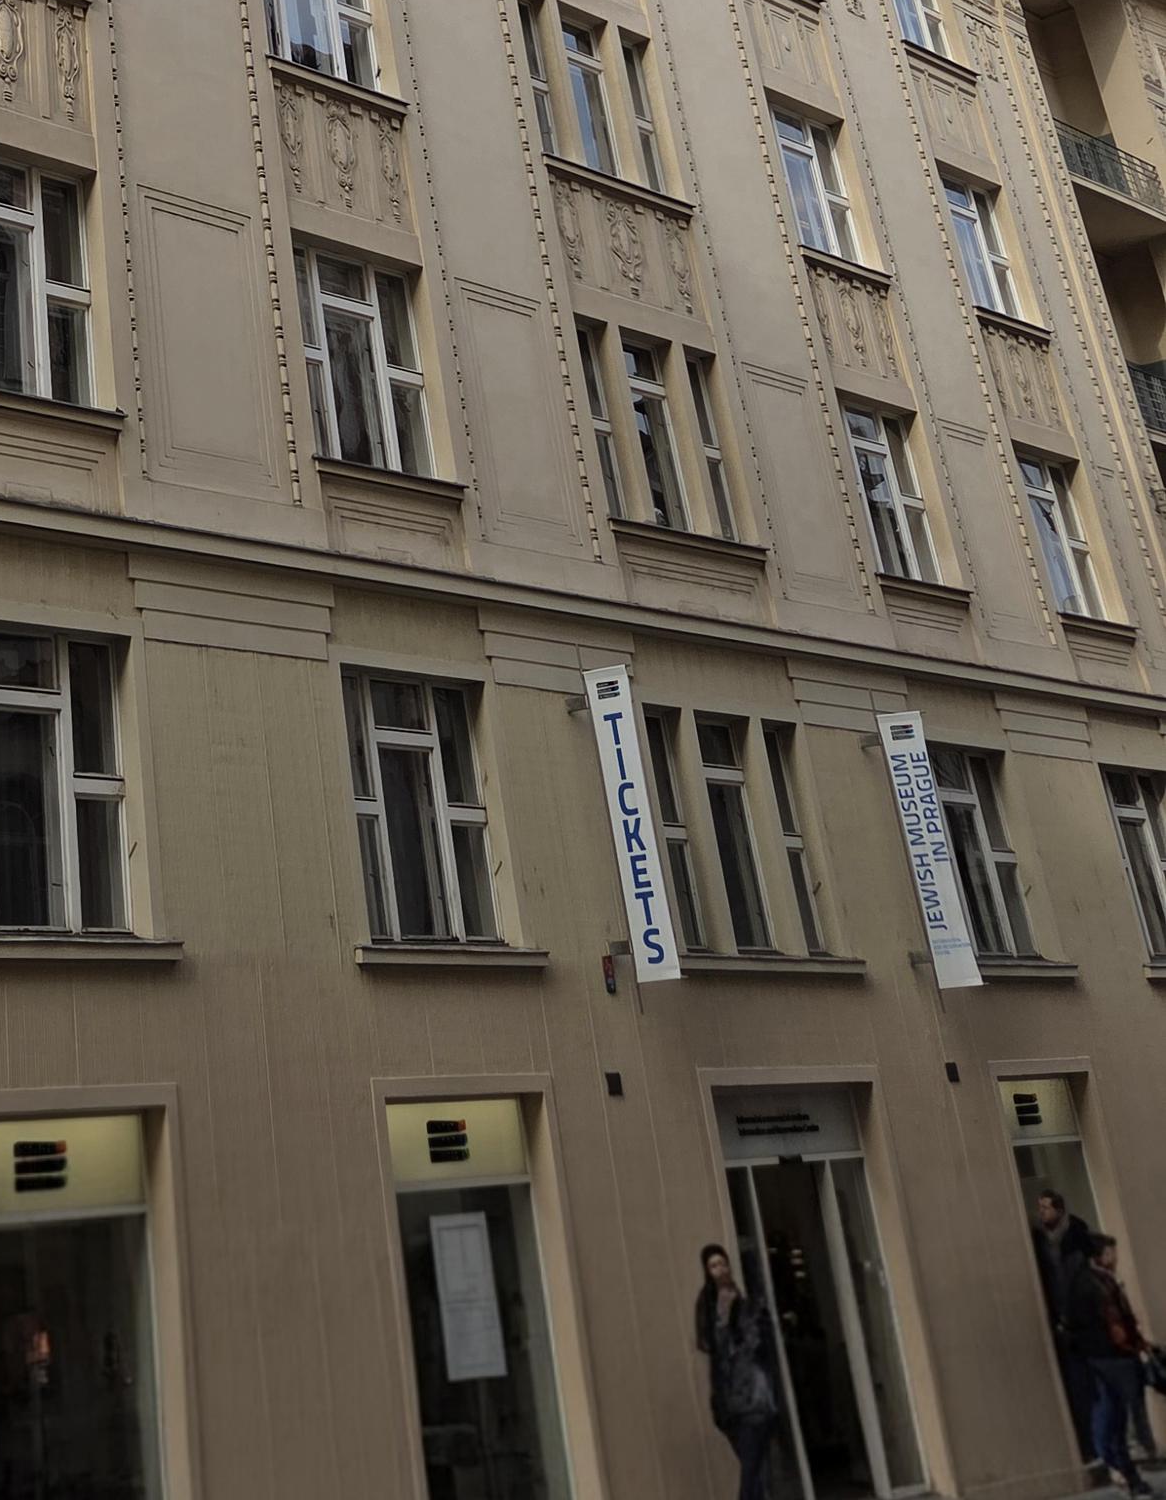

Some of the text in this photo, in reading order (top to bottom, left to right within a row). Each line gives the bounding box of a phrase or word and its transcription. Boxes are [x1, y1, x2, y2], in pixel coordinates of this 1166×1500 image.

[603, 712, 665, 965] TICKETS
[890, 753, 927, 846] MUSEUM
[909, 750, 949, 863] IN PRAGUE
[912, 853, 948, 931] JEWISH
